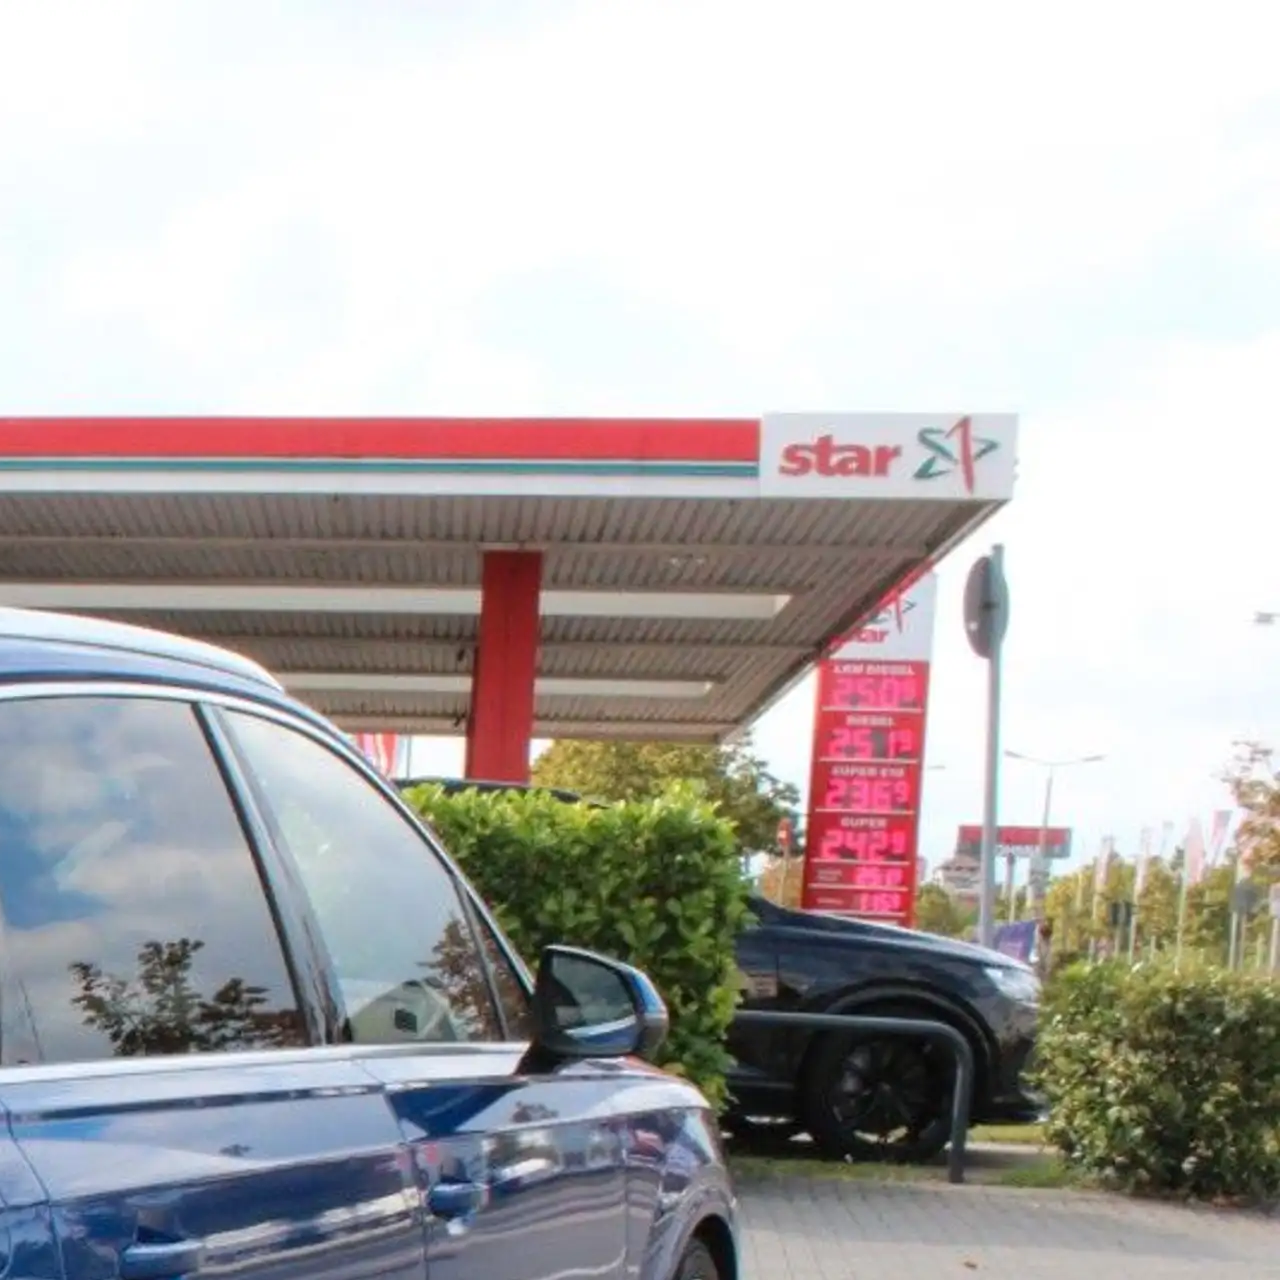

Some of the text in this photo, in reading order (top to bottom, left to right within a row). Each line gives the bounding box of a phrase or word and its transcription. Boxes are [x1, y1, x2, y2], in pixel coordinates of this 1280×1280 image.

[778, 434, 903, 477] star
[830, 764, 878, 777] SUPER
[840, 817, 887, 829] SUPER
